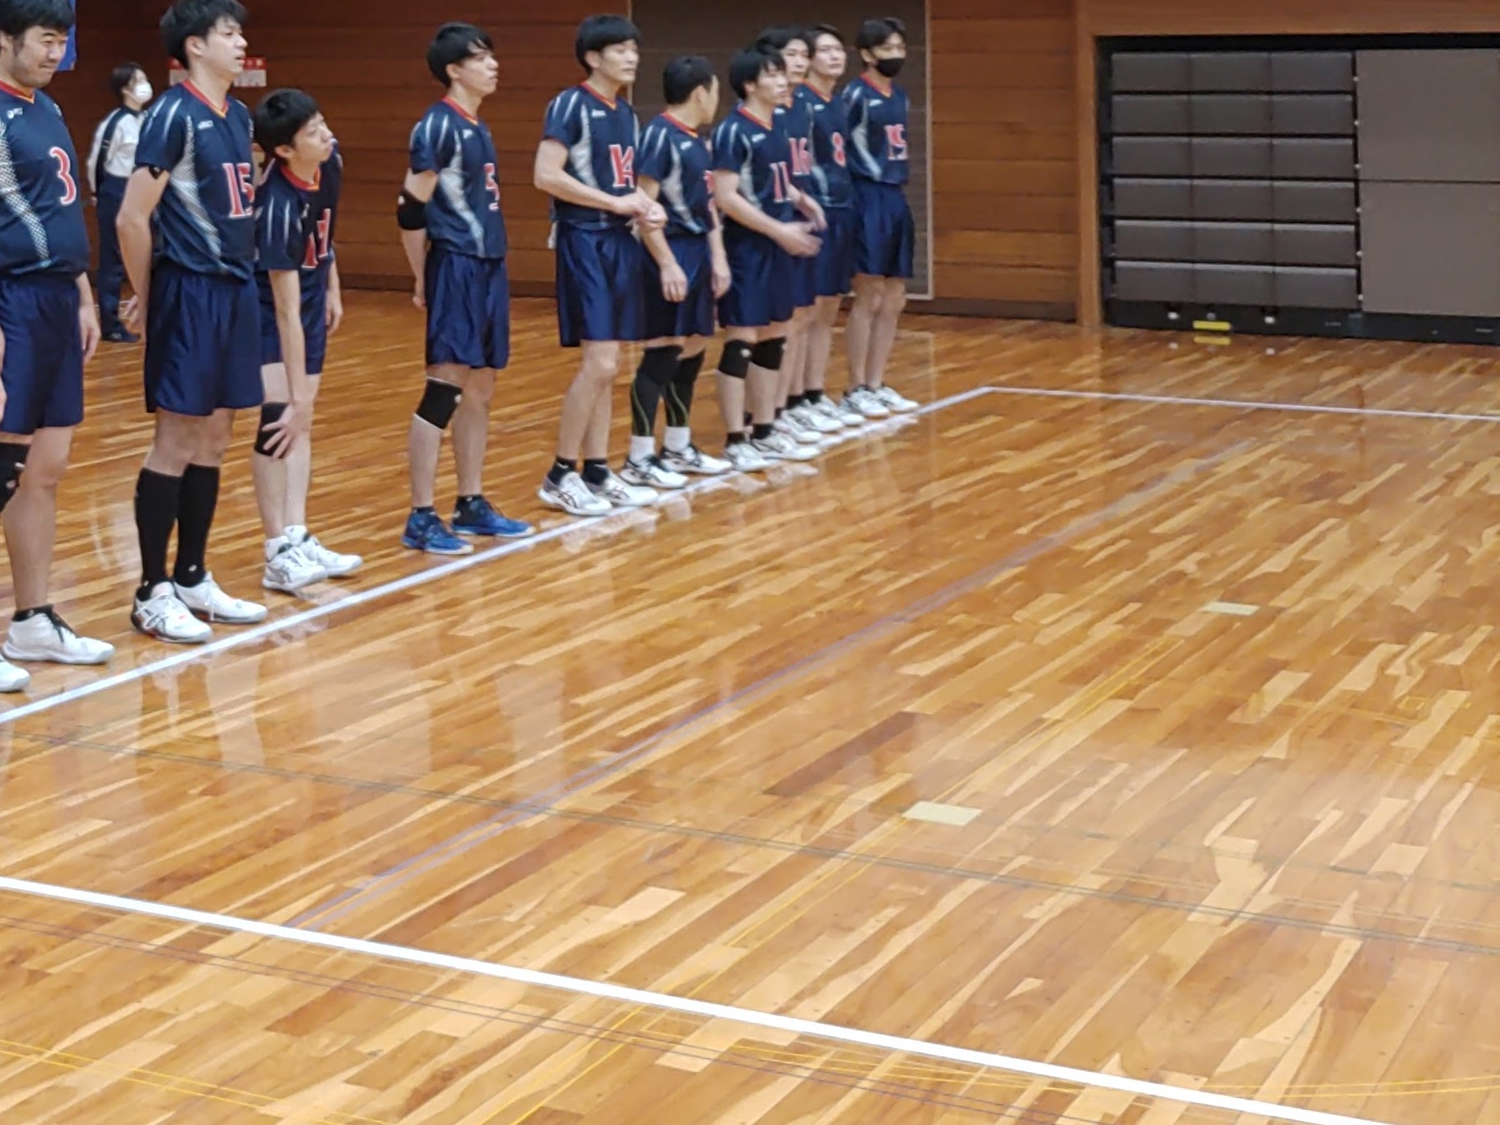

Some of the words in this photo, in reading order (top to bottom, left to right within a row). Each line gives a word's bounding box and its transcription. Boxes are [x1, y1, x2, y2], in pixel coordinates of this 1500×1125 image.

[49, 146, 77, 205] 3
[830, 131, 847, 168] 8
[222, 162, 255, 218] 15
